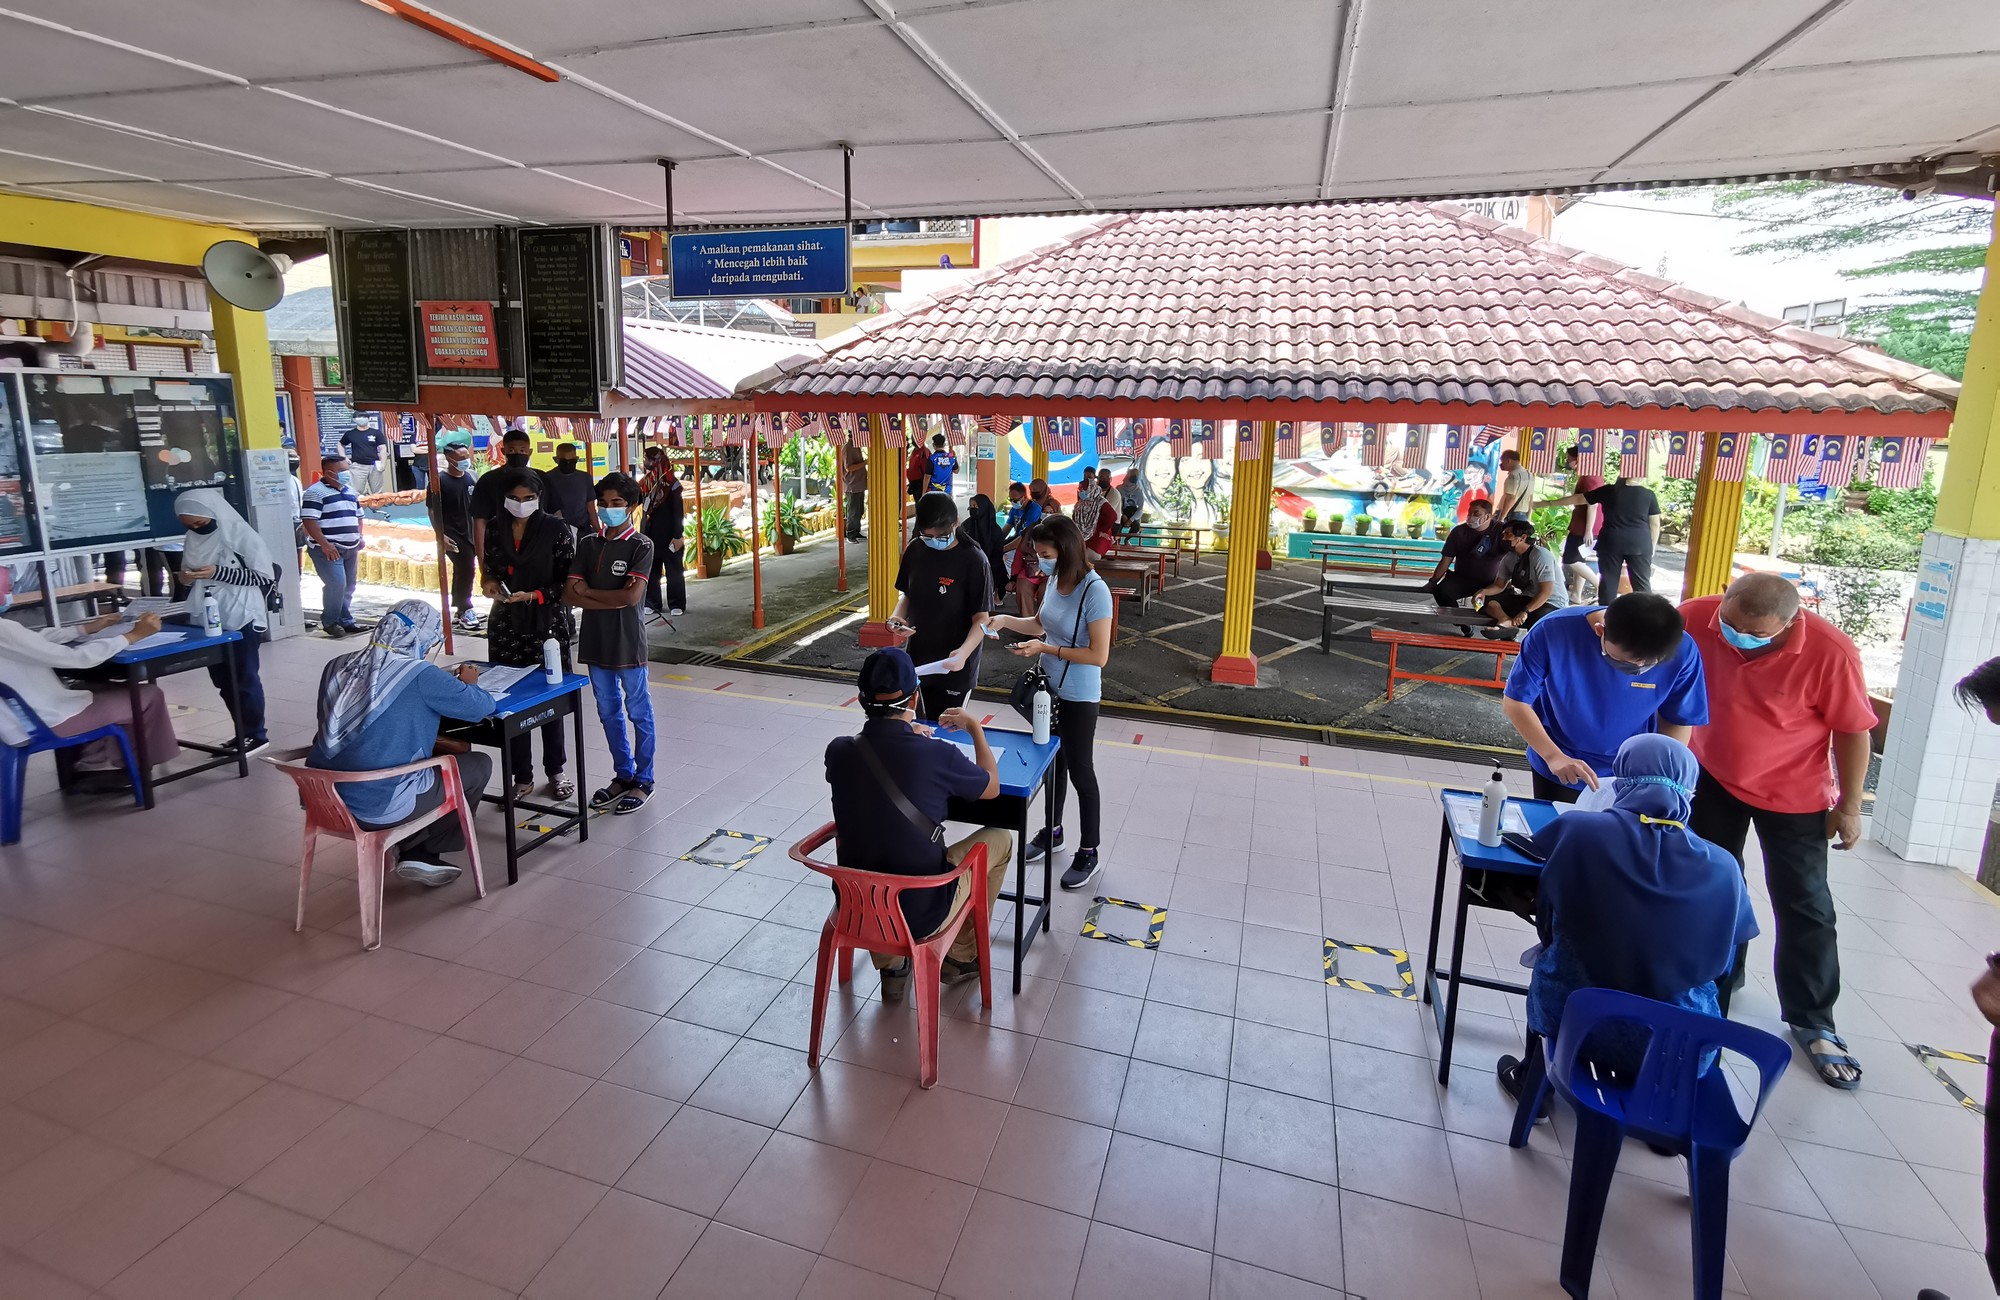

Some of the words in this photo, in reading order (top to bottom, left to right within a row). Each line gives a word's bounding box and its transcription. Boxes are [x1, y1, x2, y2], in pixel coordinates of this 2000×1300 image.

[1502, 199, 1520, 221] (A)
[699, 244, 740, 255] Amalkan
[742, 243, 795, 255] pemakanan
[797, 241, 824, 251] sihat.
[714, 257, 760, 269] Mencegah
[762, 257, 785, 267] lebih
[788, 256, 809, 266] baik
[711, 273, 750, 285] daripada
[752, 270, 805, 283] mengubati.
[429, 313, 448, 322] TERIMA
[449, 313, 466, 322] KASIH
[466, 314, 484, 322] CIKGU
[430, 325, 455, 333] MAAFKAN
[455, 325, 468, 333] SAYA
[468, 325, 487, 334] CIKGU
[471, 337, 490, 345] CIKGU
[457, 348, 470, 357] SAYA
[470, 348, 489, 357] CIKGU
